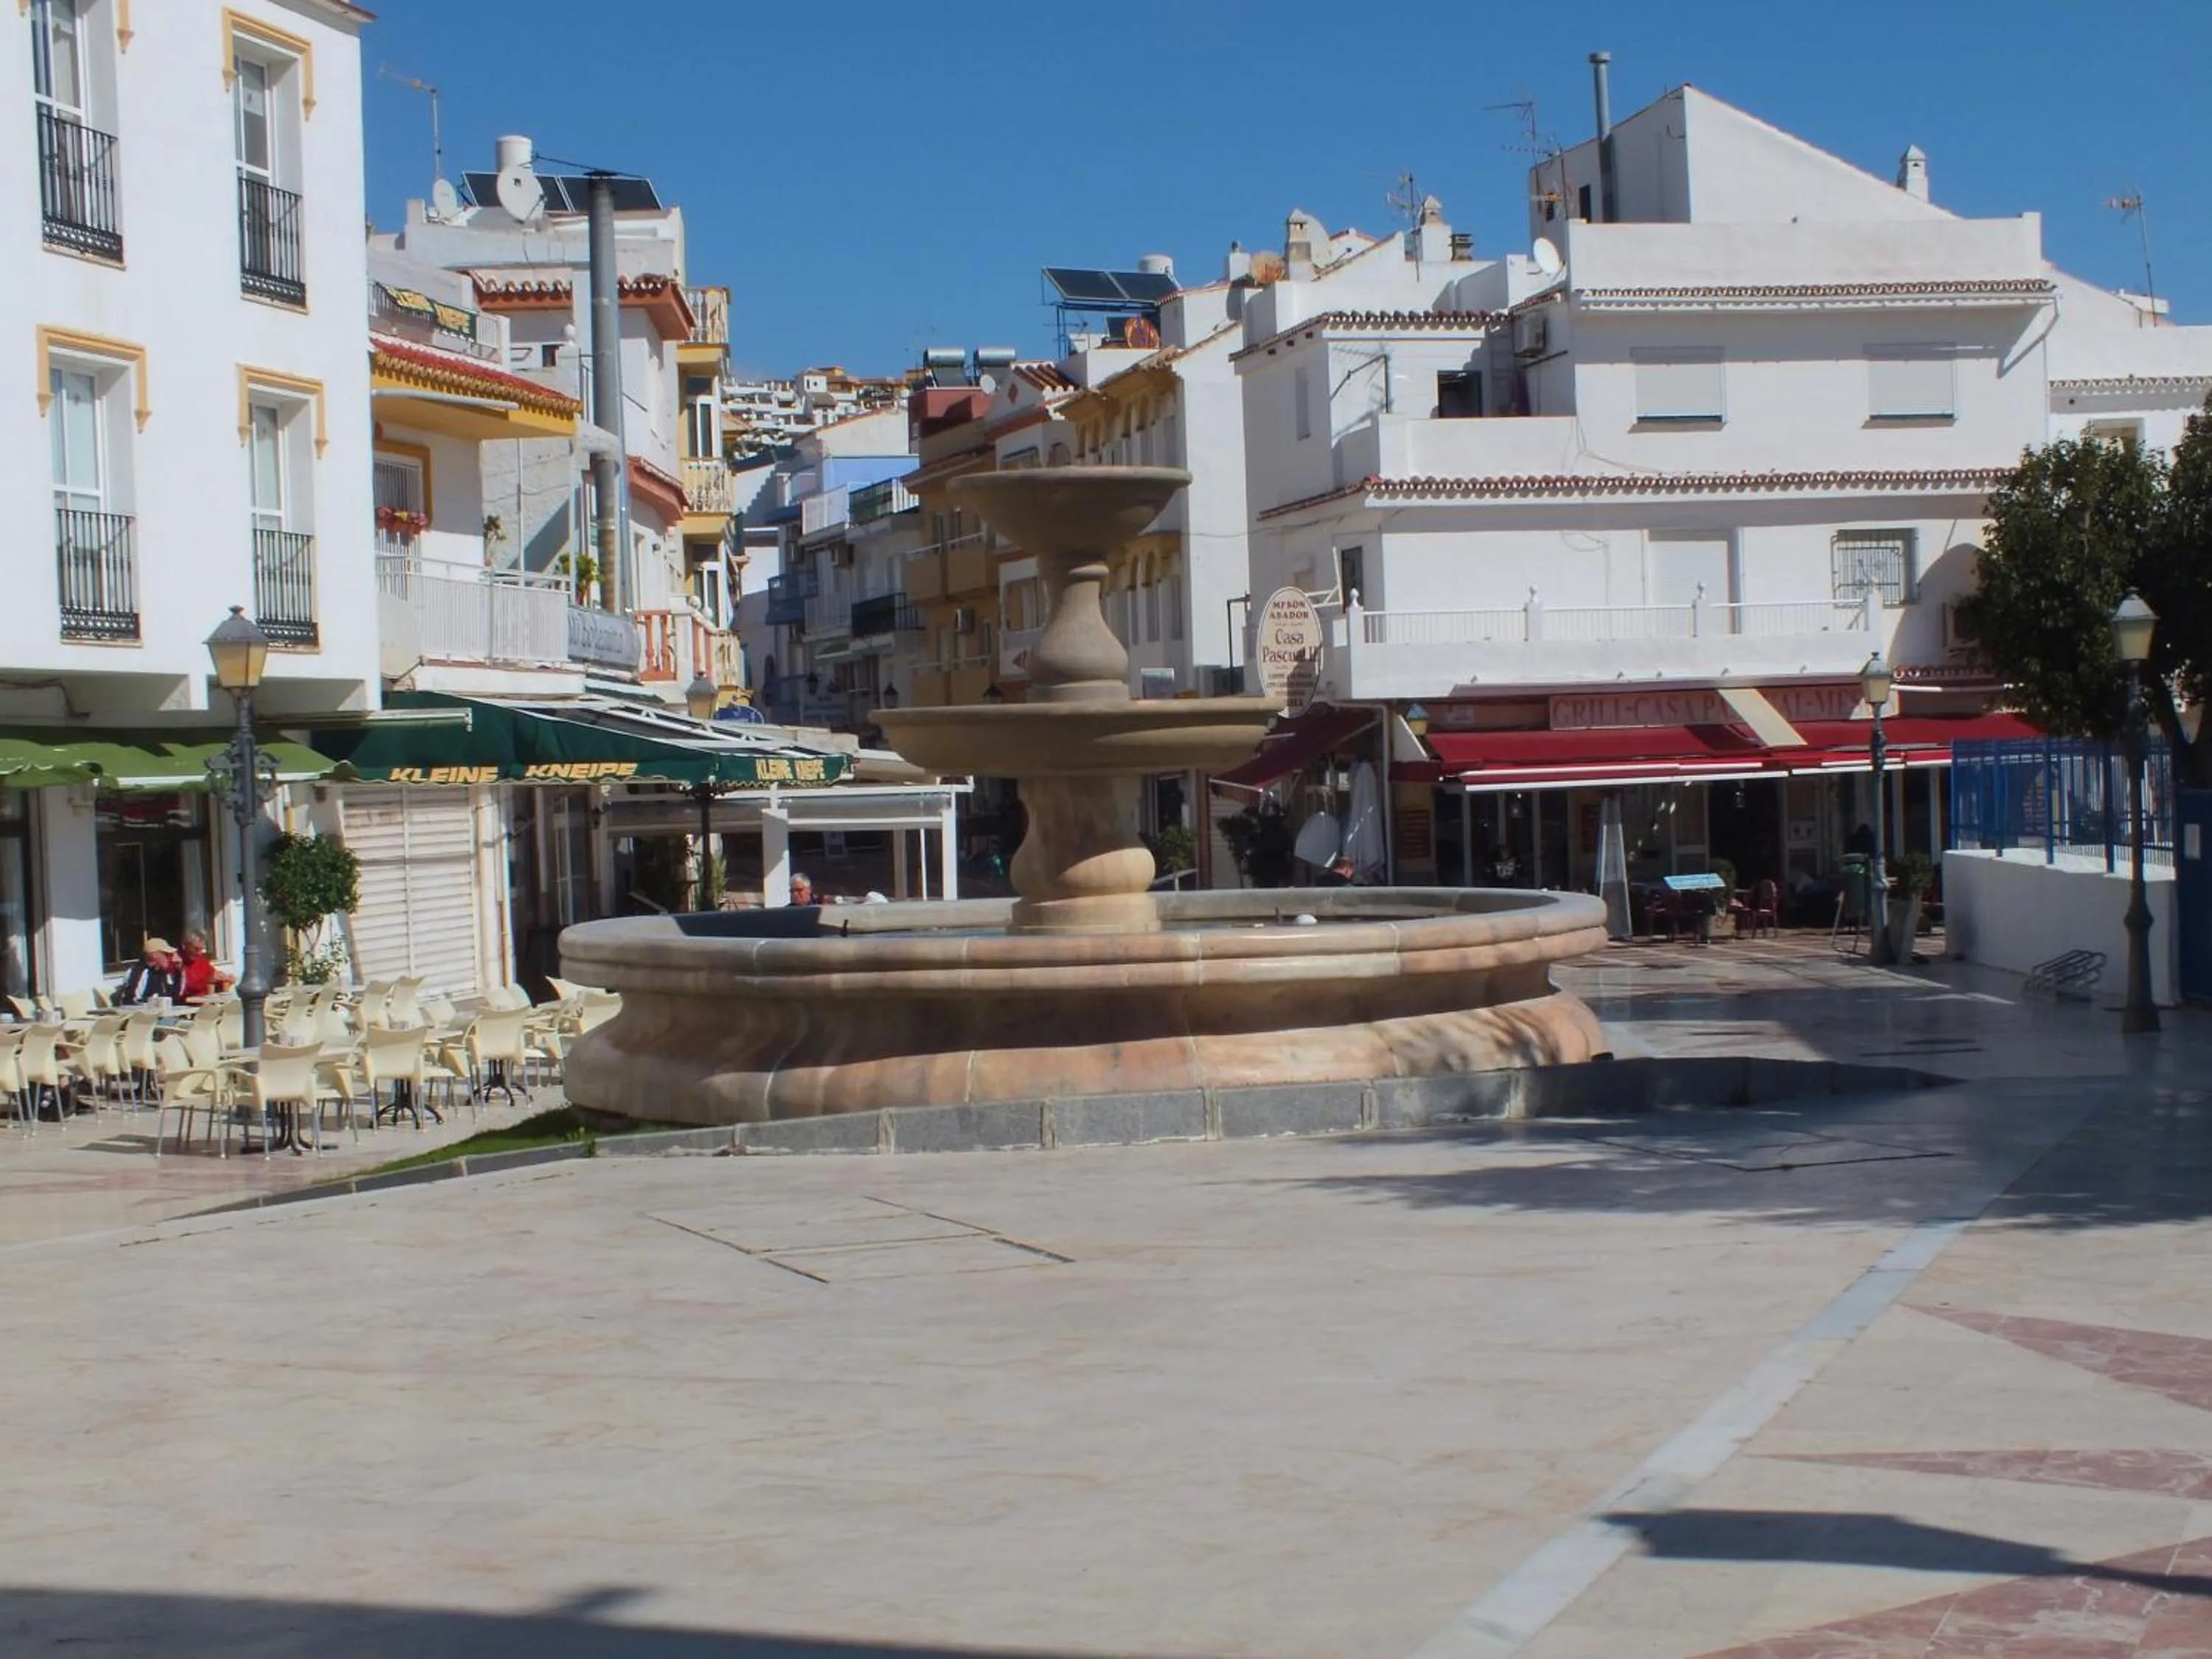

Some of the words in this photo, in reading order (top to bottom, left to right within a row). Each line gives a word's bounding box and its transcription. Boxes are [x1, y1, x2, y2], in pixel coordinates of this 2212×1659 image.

[1276, 627, 1304, 645] Casa
[389, 766, 498, 783] KLEINE
[525, 762, 638, 778] KNEIPE
